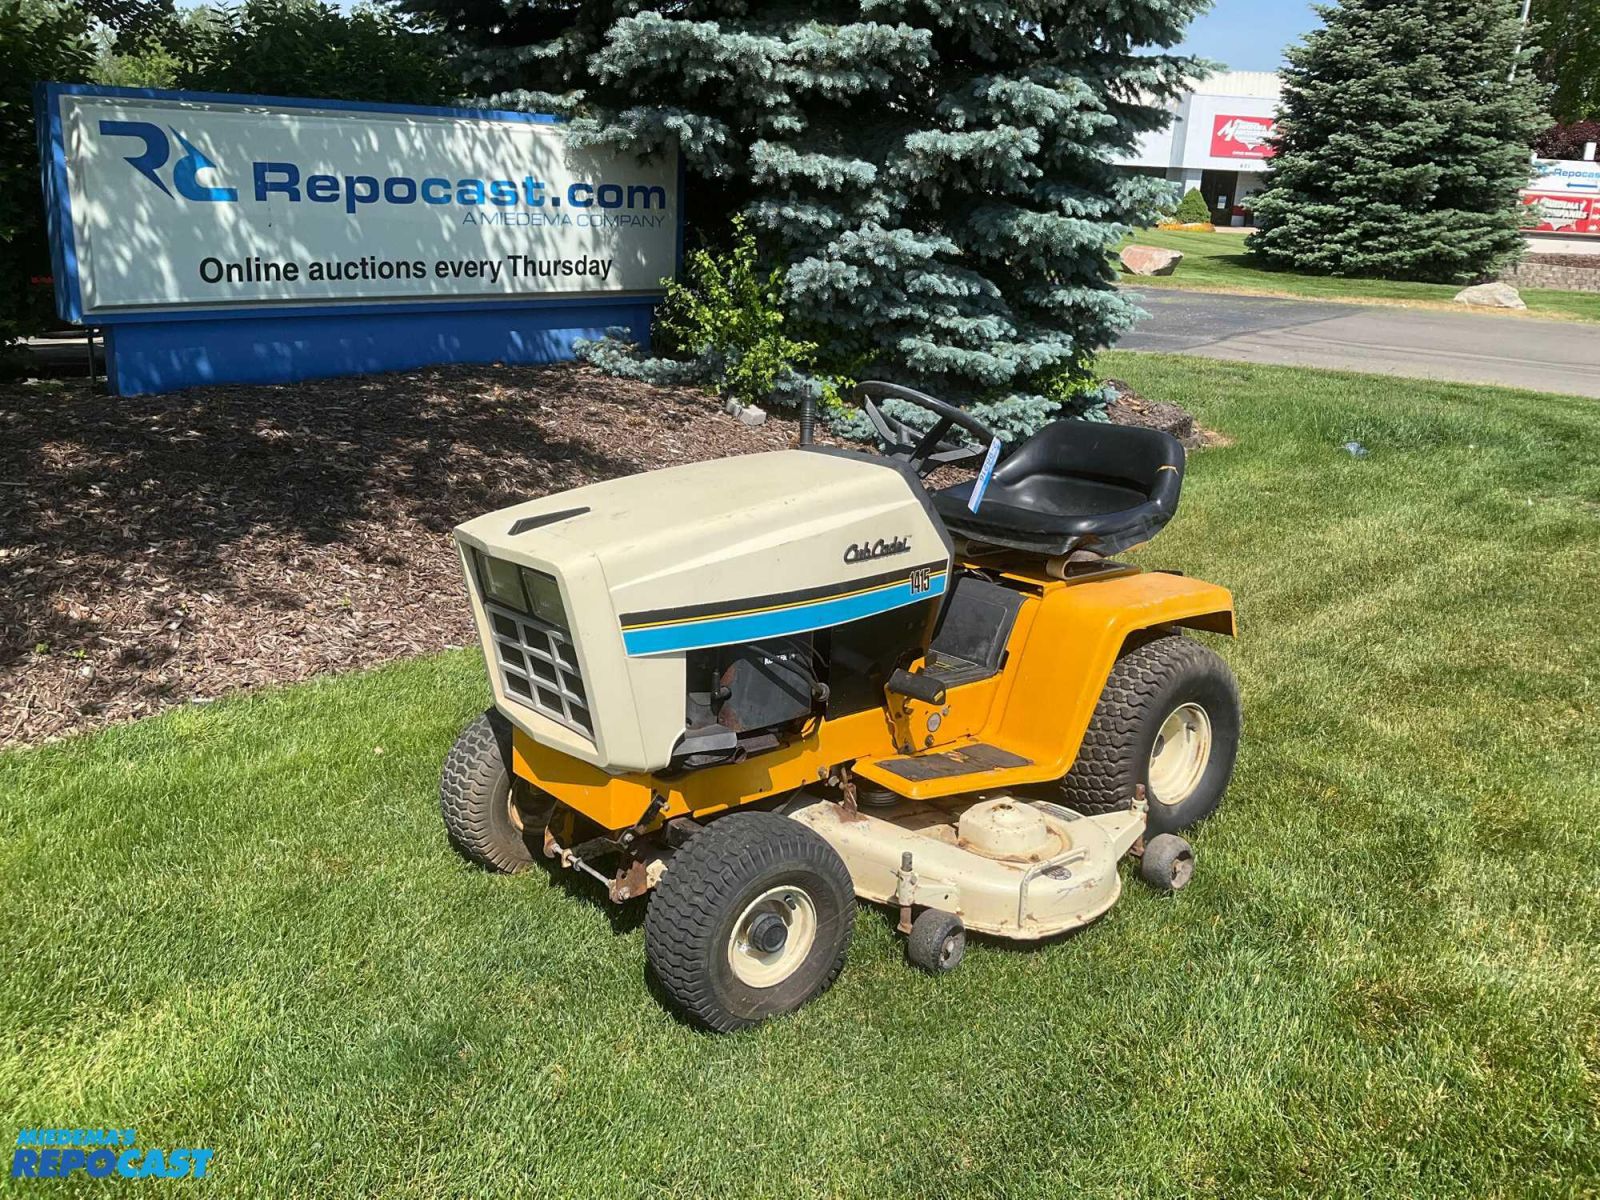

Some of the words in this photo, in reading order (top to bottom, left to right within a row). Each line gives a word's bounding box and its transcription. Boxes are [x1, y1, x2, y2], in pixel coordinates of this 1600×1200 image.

[253, 161, 666, 214] Repocast.com
[462, 211, 478, 226] A
[481, 211, 573, 227] MIEDEMA
[576, 213, 666, 228] COMPANY
[199, 256, 299, 284] Online
[308, 255, 427, 282] auctions
[434, 259, 502, 283] every
[507, 254, 613, 280] Thursday
[844, 541, 872, 565] Cub
[872, 536, 911, 559] Cadet
[909, 568, 931, 595] 1415
